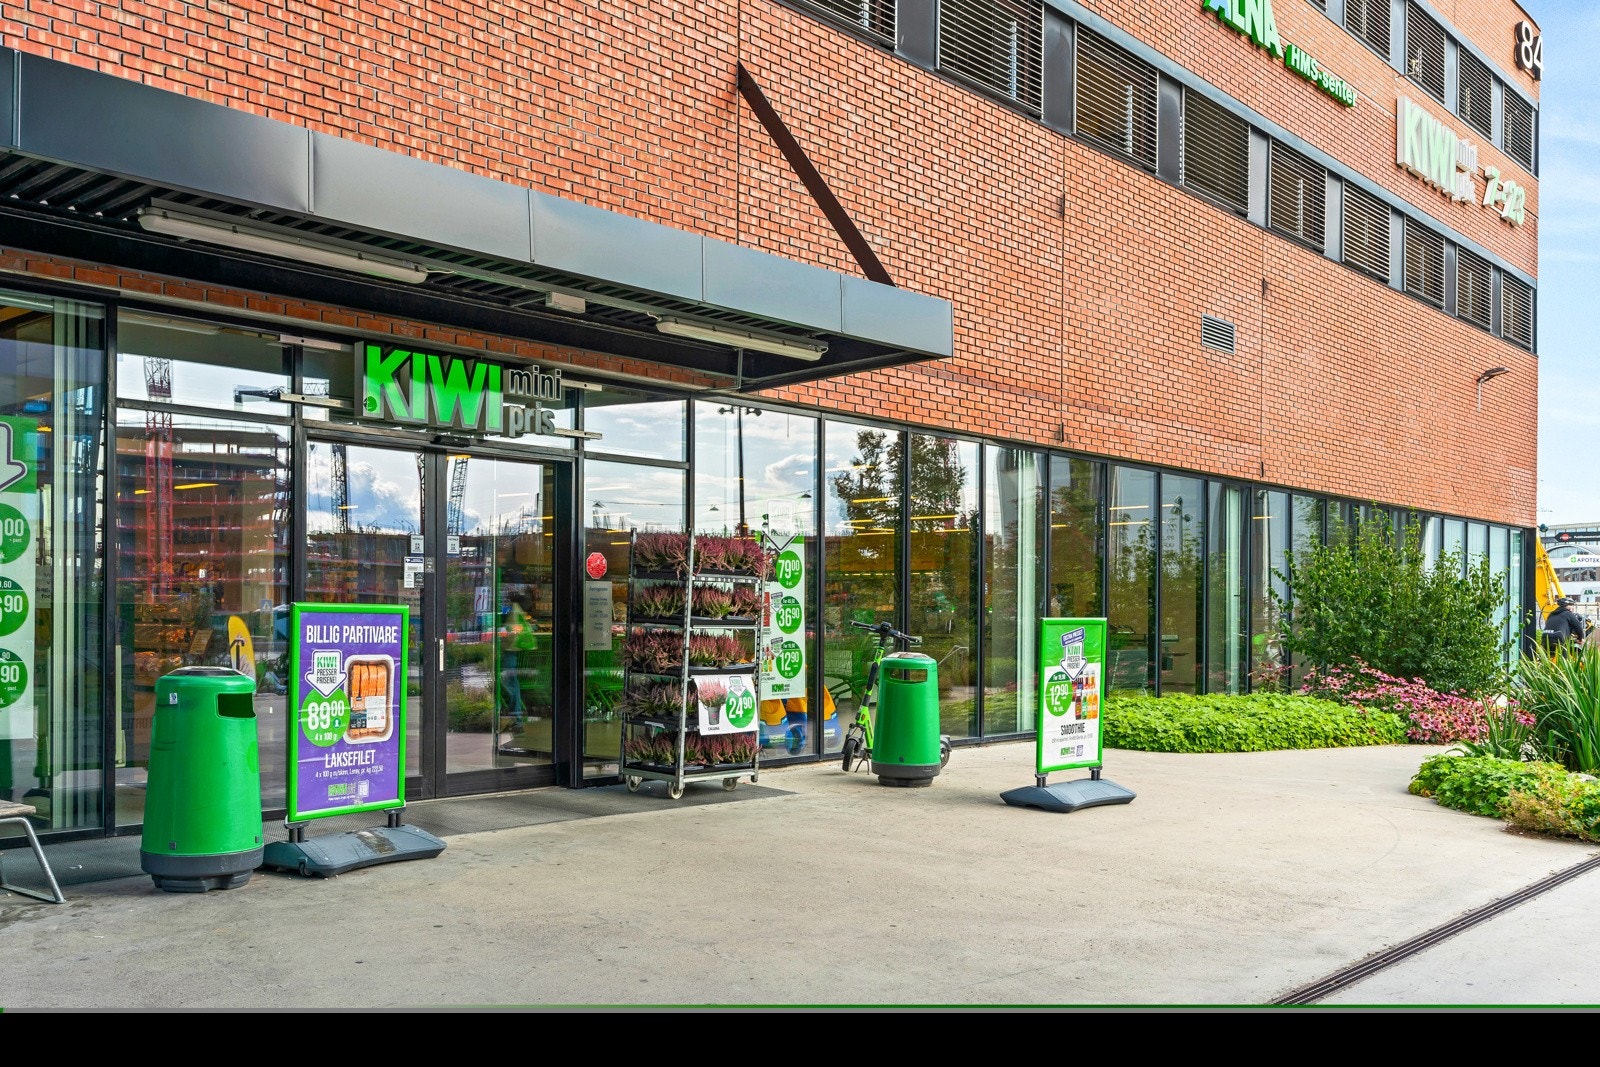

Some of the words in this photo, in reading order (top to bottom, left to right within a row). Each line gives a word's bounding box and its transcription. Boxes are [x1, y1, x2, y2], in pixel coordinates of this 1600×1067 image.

[1516, 20, 1544, 81] 84
[1287, 44, 1357, 106] HMS-senter
[1403, 99, 1457, 198] KIWI
[1483, 166, 1525, 225] 7-23
[364, 344, 503, 433] KIWI
[508, 365, 562, 400] mini
[508, 402, 556, 438] pris
[306, 625, 340, 643] BILLIG
[342, 626, 398, 643] PARTIVARE
[316, 656, 337, 667] KIWI
[1067, 645, 1080, 656] KIWI
[316, 668, 337, 676] PRESSER
[316, 676, 337, 684] PRISENE!
[307, 700, 344, 730] 8900
[729, 696, 753, 719] 2490
[314, 733, 319, 741] 4
[1060, 722, 1085, 736] SMOOTHIE
[325, 749, 376, 769] LAKSEFILET
